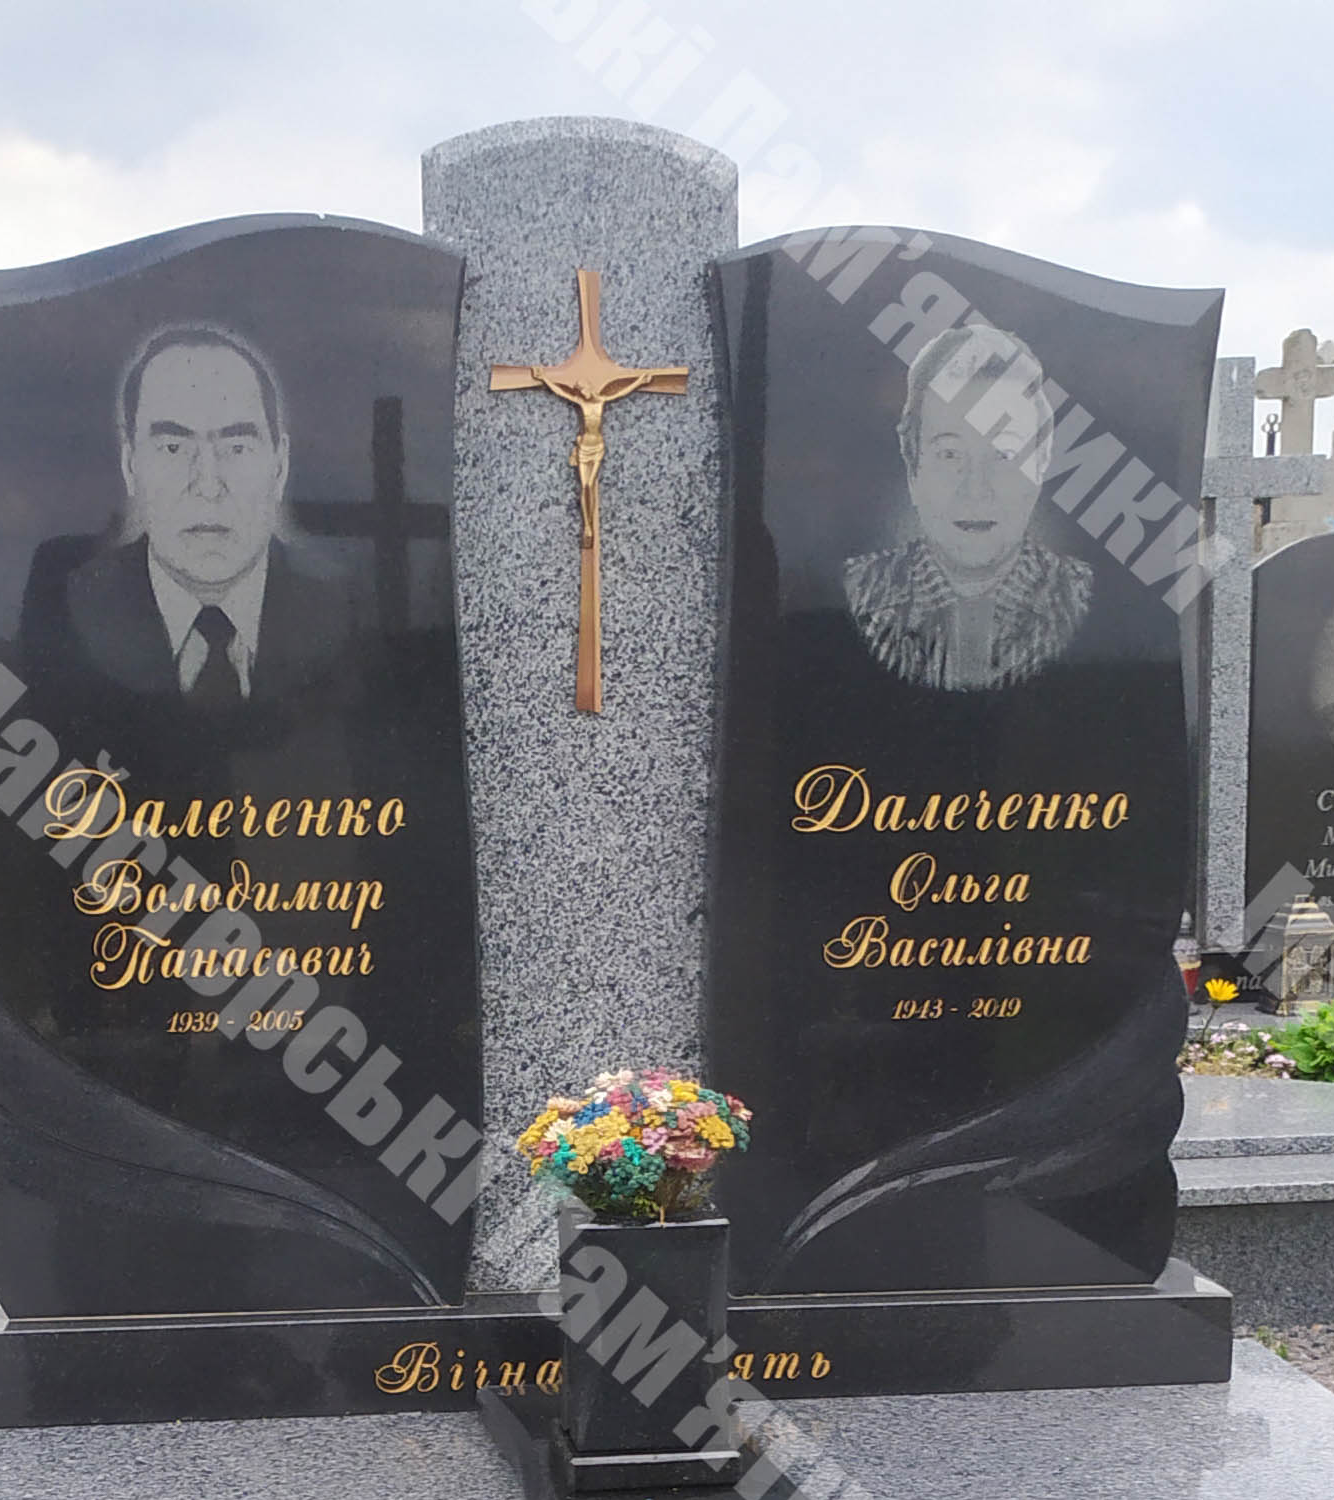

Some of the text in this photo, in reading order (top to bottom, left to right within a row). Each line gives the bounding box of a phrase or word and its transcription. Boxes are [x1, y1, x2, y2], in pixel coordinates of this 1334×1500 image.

[44, 768, 405, 841] Далеченко
[792, 764, 1130, 834] Далеченко
[73, 858, 385, 929] Володимир
[889, 852, 1031, 912] Ольга
[90, 921, 373, 990] Панасович
[823, 914, 1092, 970] Василівна
[167, 1010, 220, 1034] 1939
[248, 1009, 304, 1033] 2005
[892, 998, 944, 1021] 1943
[969, 998, 1023, 1020] 2019
[374, 1341, 833, 1393] Вічна ять
